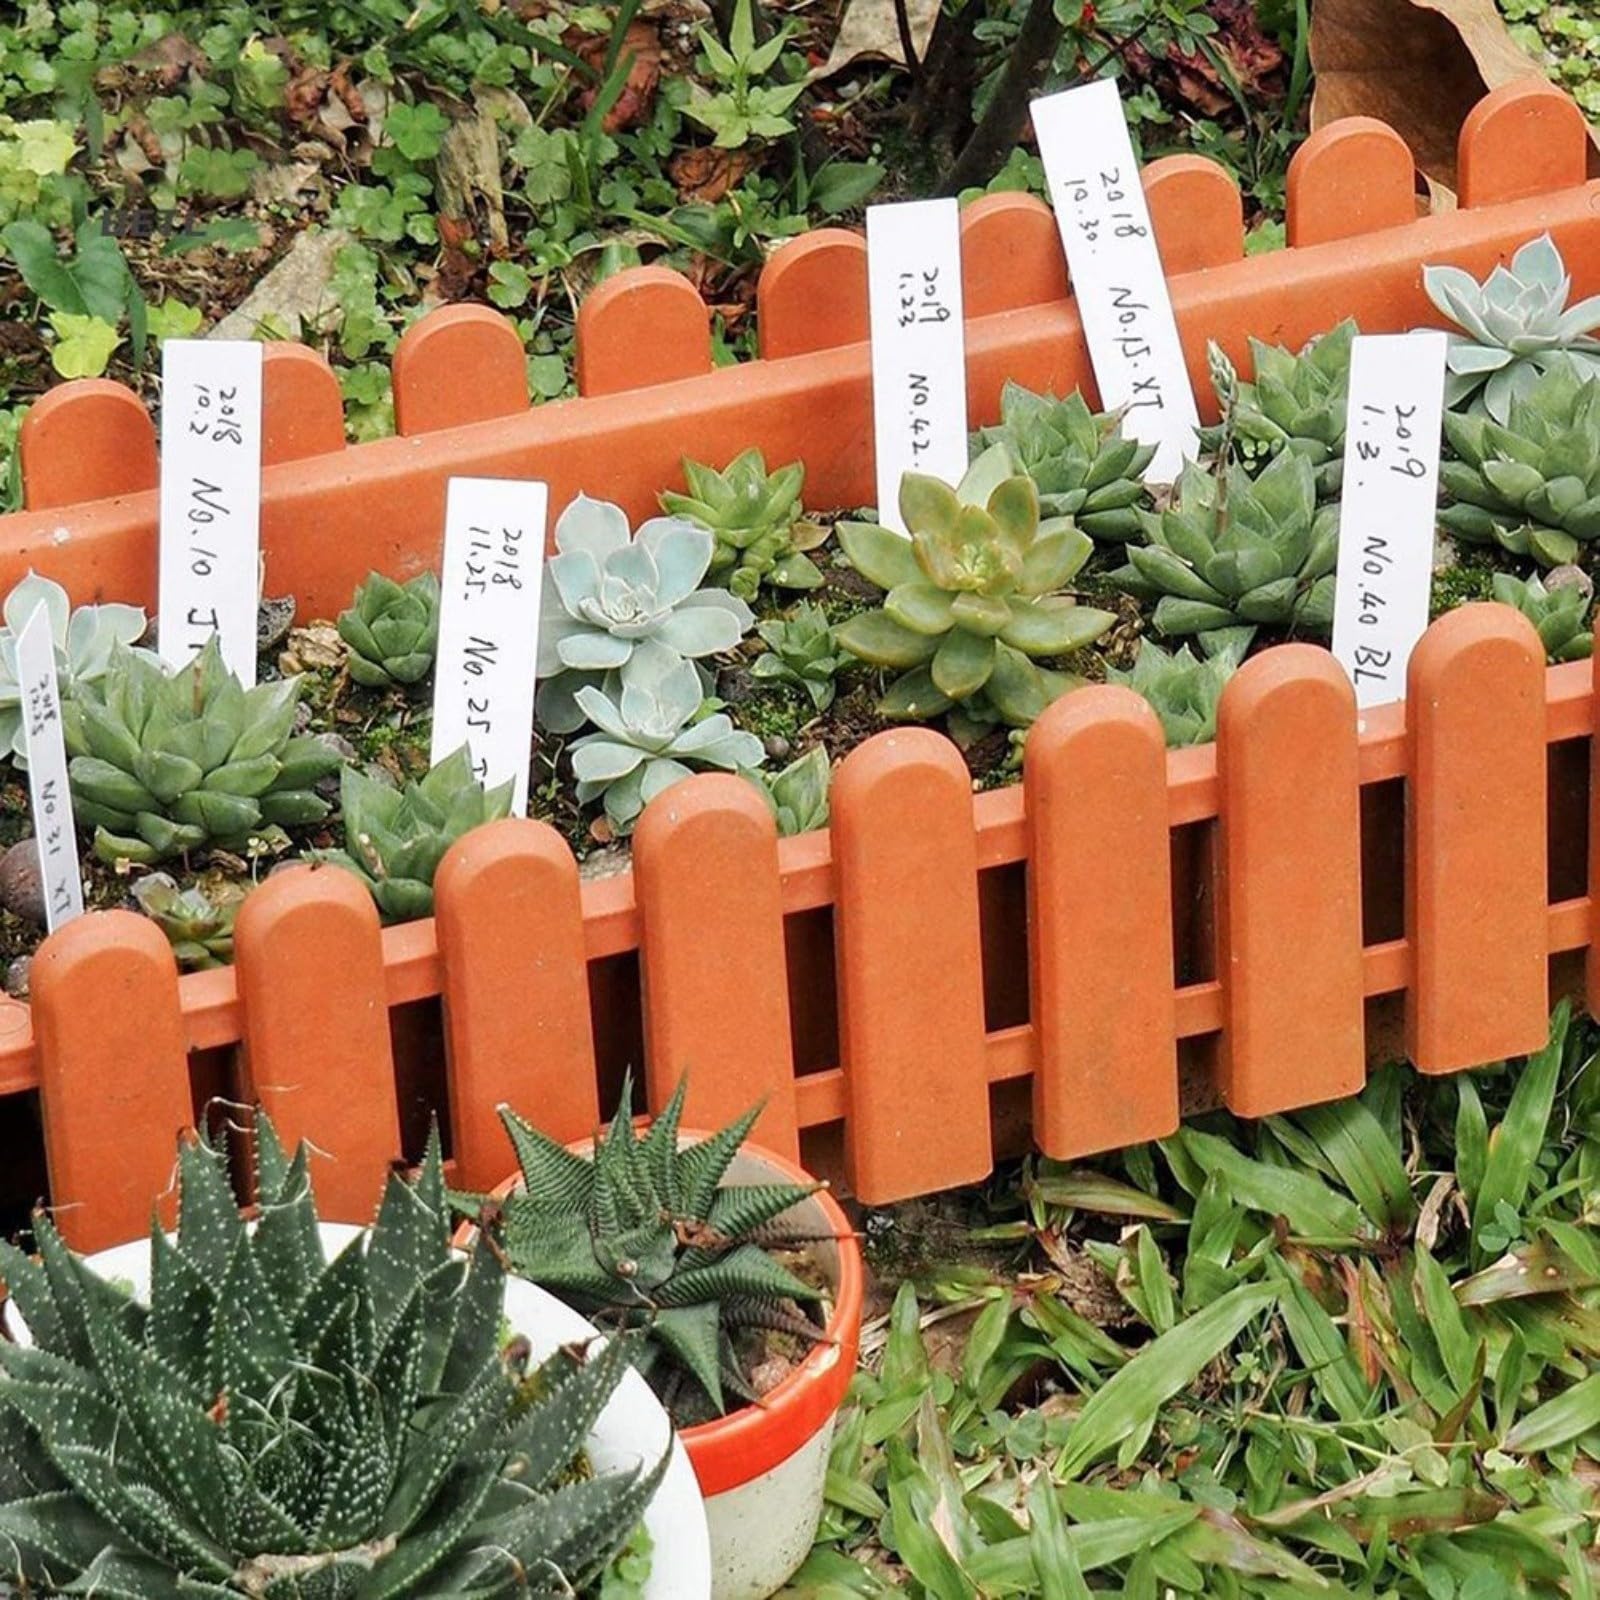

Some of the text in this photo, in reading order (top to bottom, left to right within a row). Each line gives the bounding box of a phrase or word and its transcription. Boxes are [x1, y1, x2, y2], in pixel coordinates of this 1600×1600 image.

[1100, 168, 1148, 238] 2018
[917, 267, 951, 323] 2019
[189, 384, 211, 436] 10.2
[211, 386, 243, 444] 2018
[1389, 404, 1427, 479] 2019
[491, 527, 523, 591] 2018
[1352, 645, 1392, 687] BL
